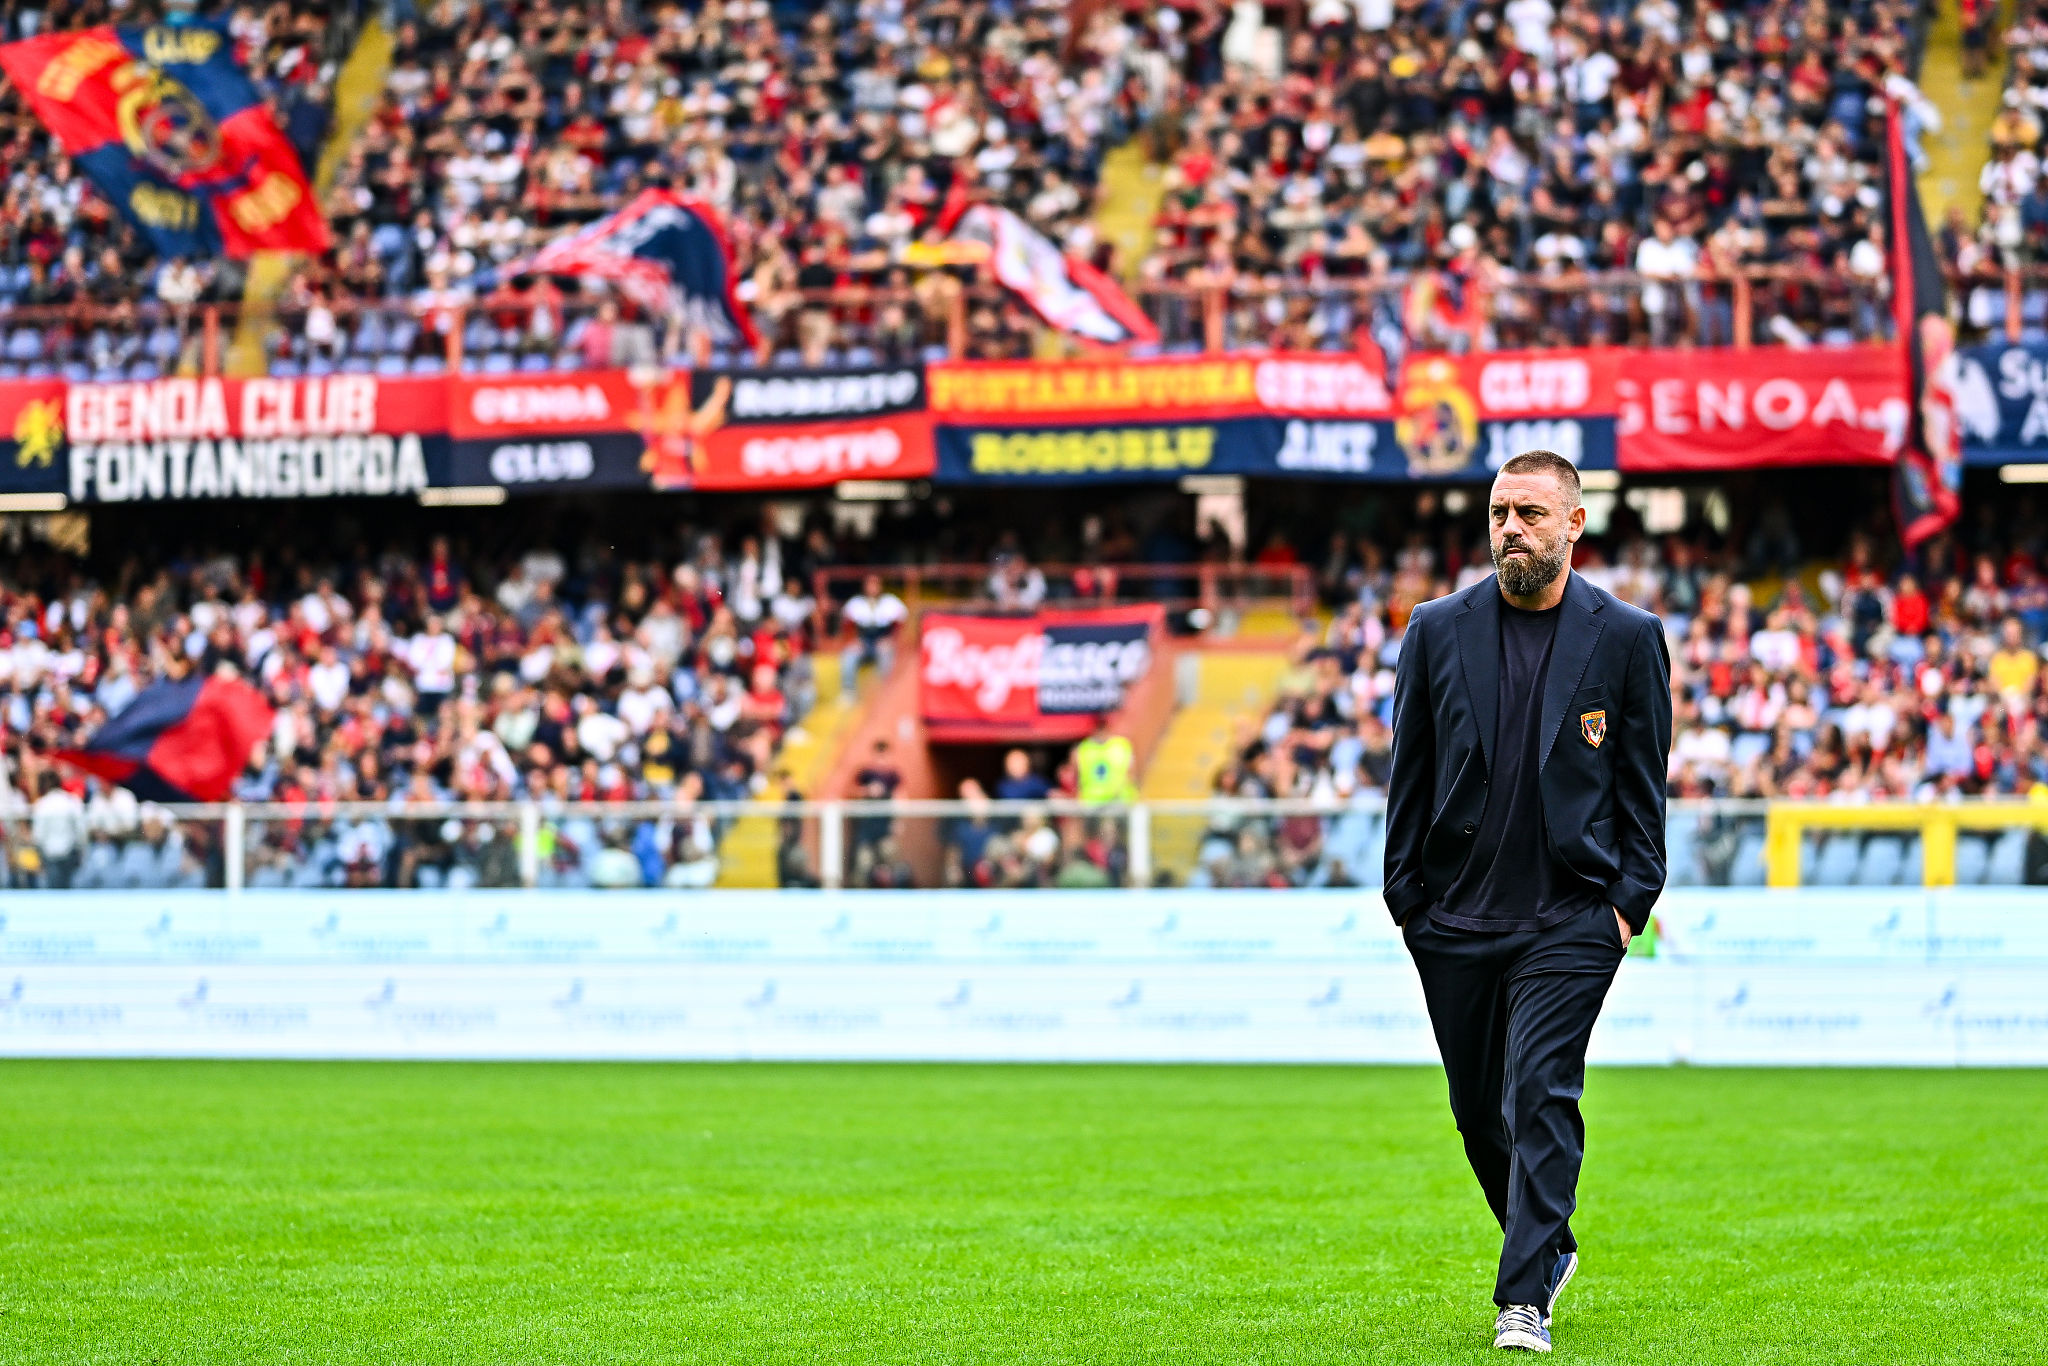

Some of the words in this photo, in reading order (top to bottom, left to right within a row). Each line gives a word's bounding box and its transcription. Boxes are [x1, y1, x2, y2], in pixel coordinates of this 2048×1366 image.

[68, 379, 229, 441] GENOA
[242, 375, 378, 436] CLUB
[472, 384, 610, 425] GENOA
[733, 371, 919, 417] ROBERTO
[1480, 358, 1590, 412] CLUB
[68, 433, 428, 501] FONTANIGORDA
[490, 440, 594, 483] CLUB
[741, 428, 901, 477] SCOTTO
[969, 427, 1216, 474] ROSSOBLU
